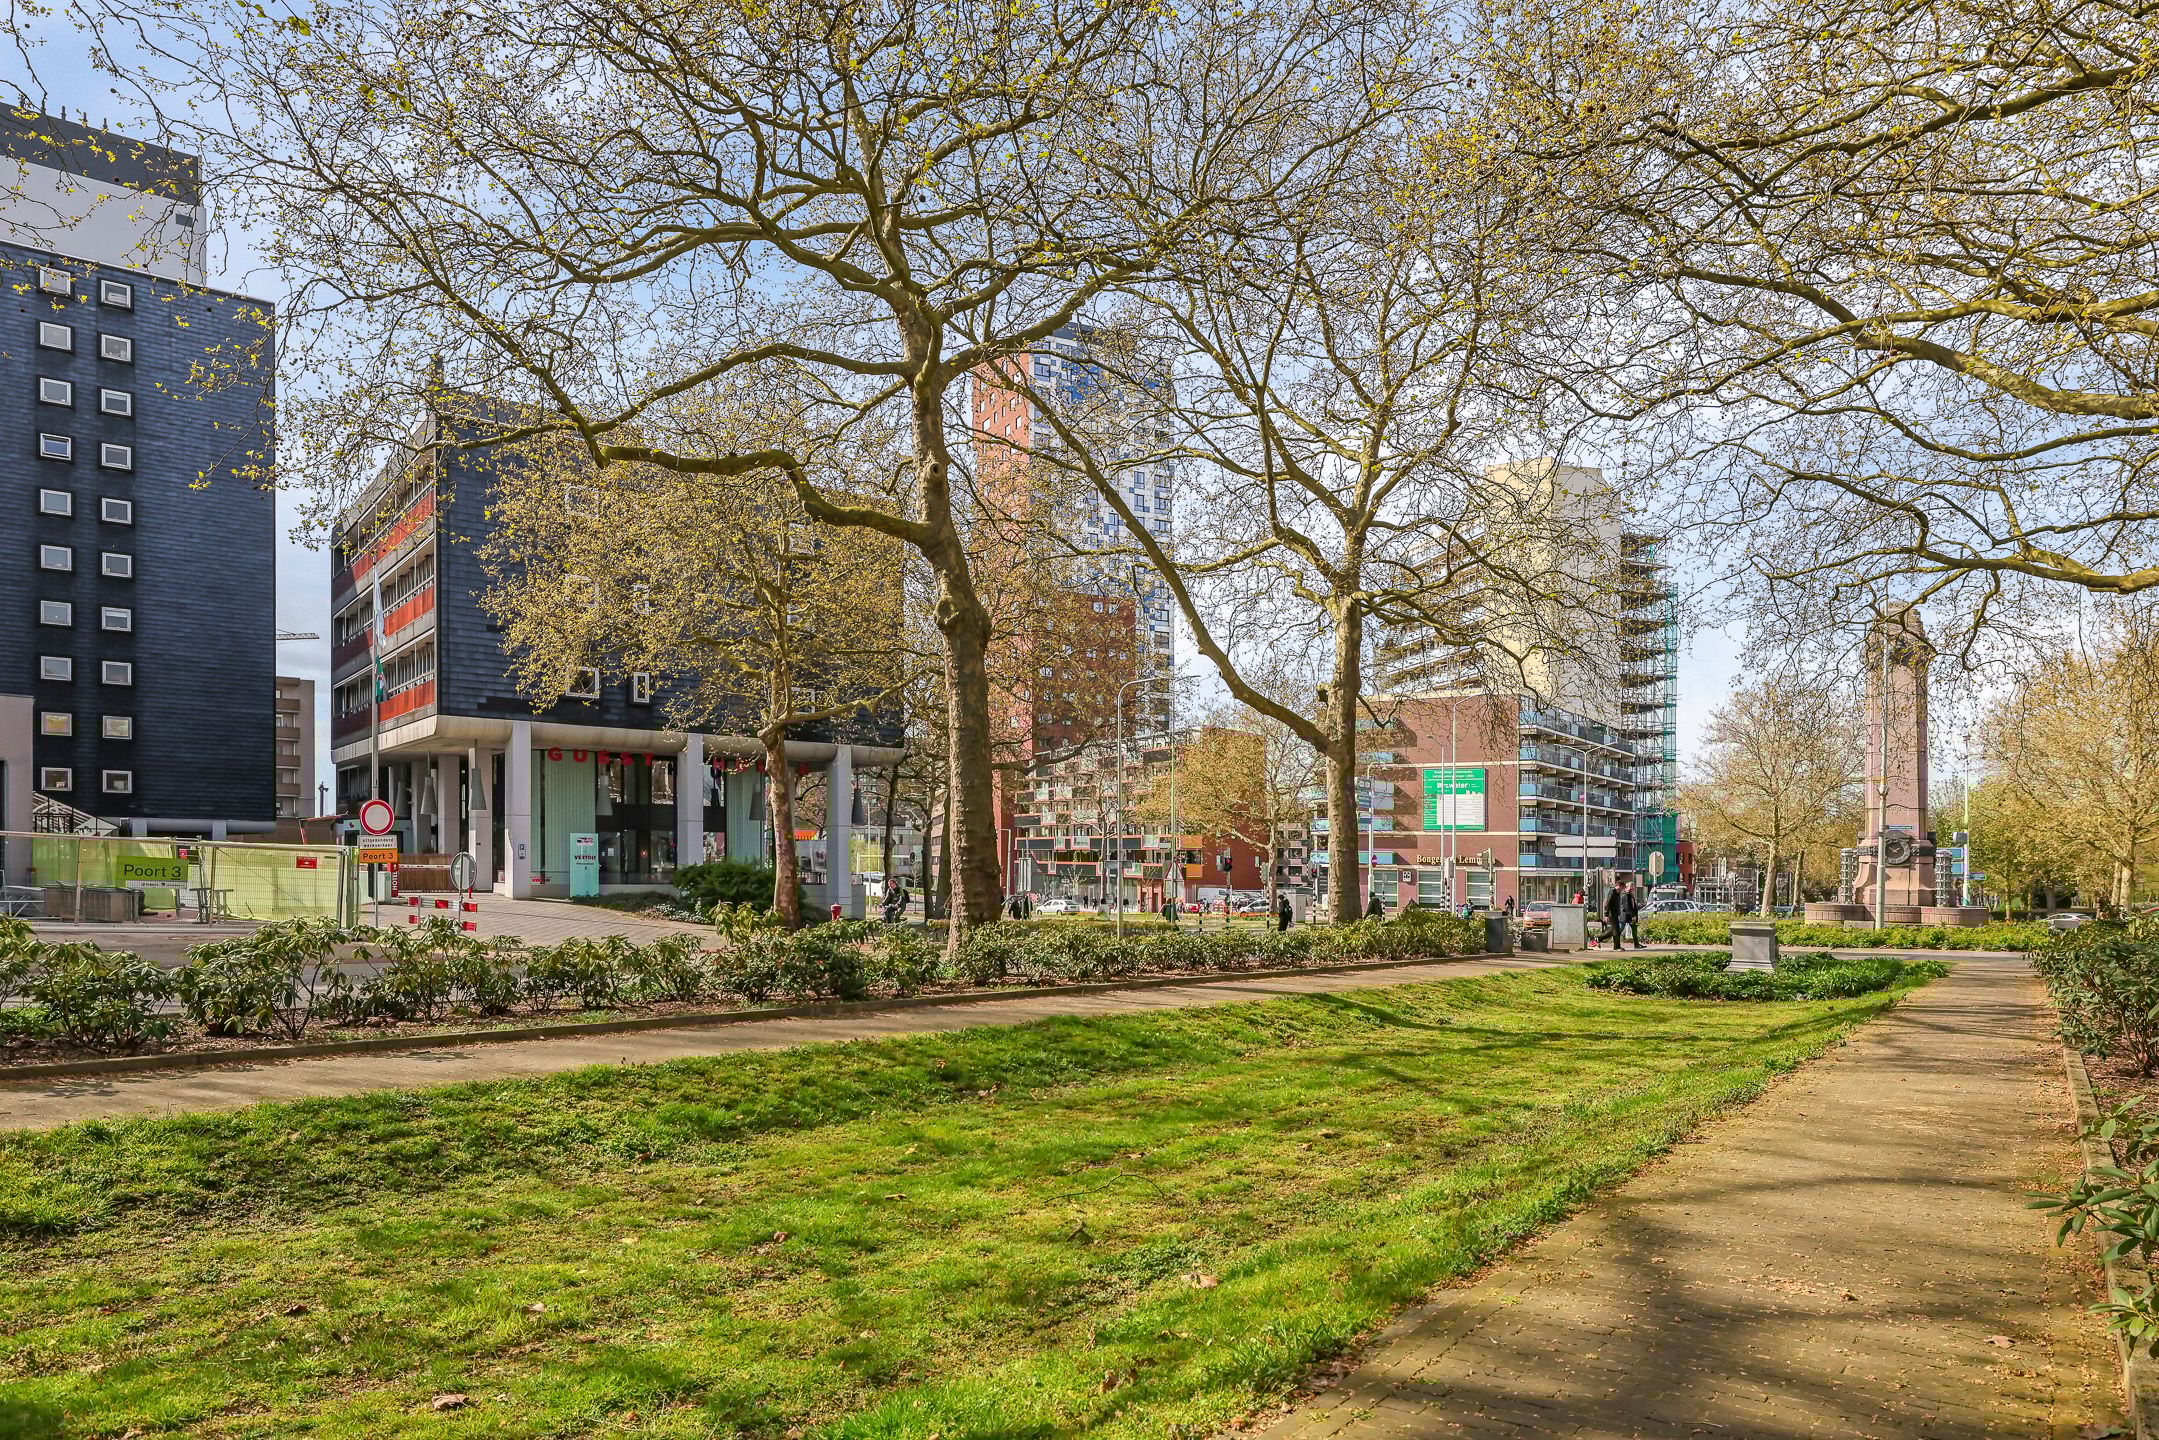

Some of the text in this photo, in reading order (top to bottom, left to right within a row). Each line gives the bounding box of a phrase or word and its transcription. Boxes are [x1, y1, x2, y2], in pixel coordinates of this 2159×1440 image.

[547, 747, 654, 767] GUEST
[124, 864, 181, 878] Poort 3
